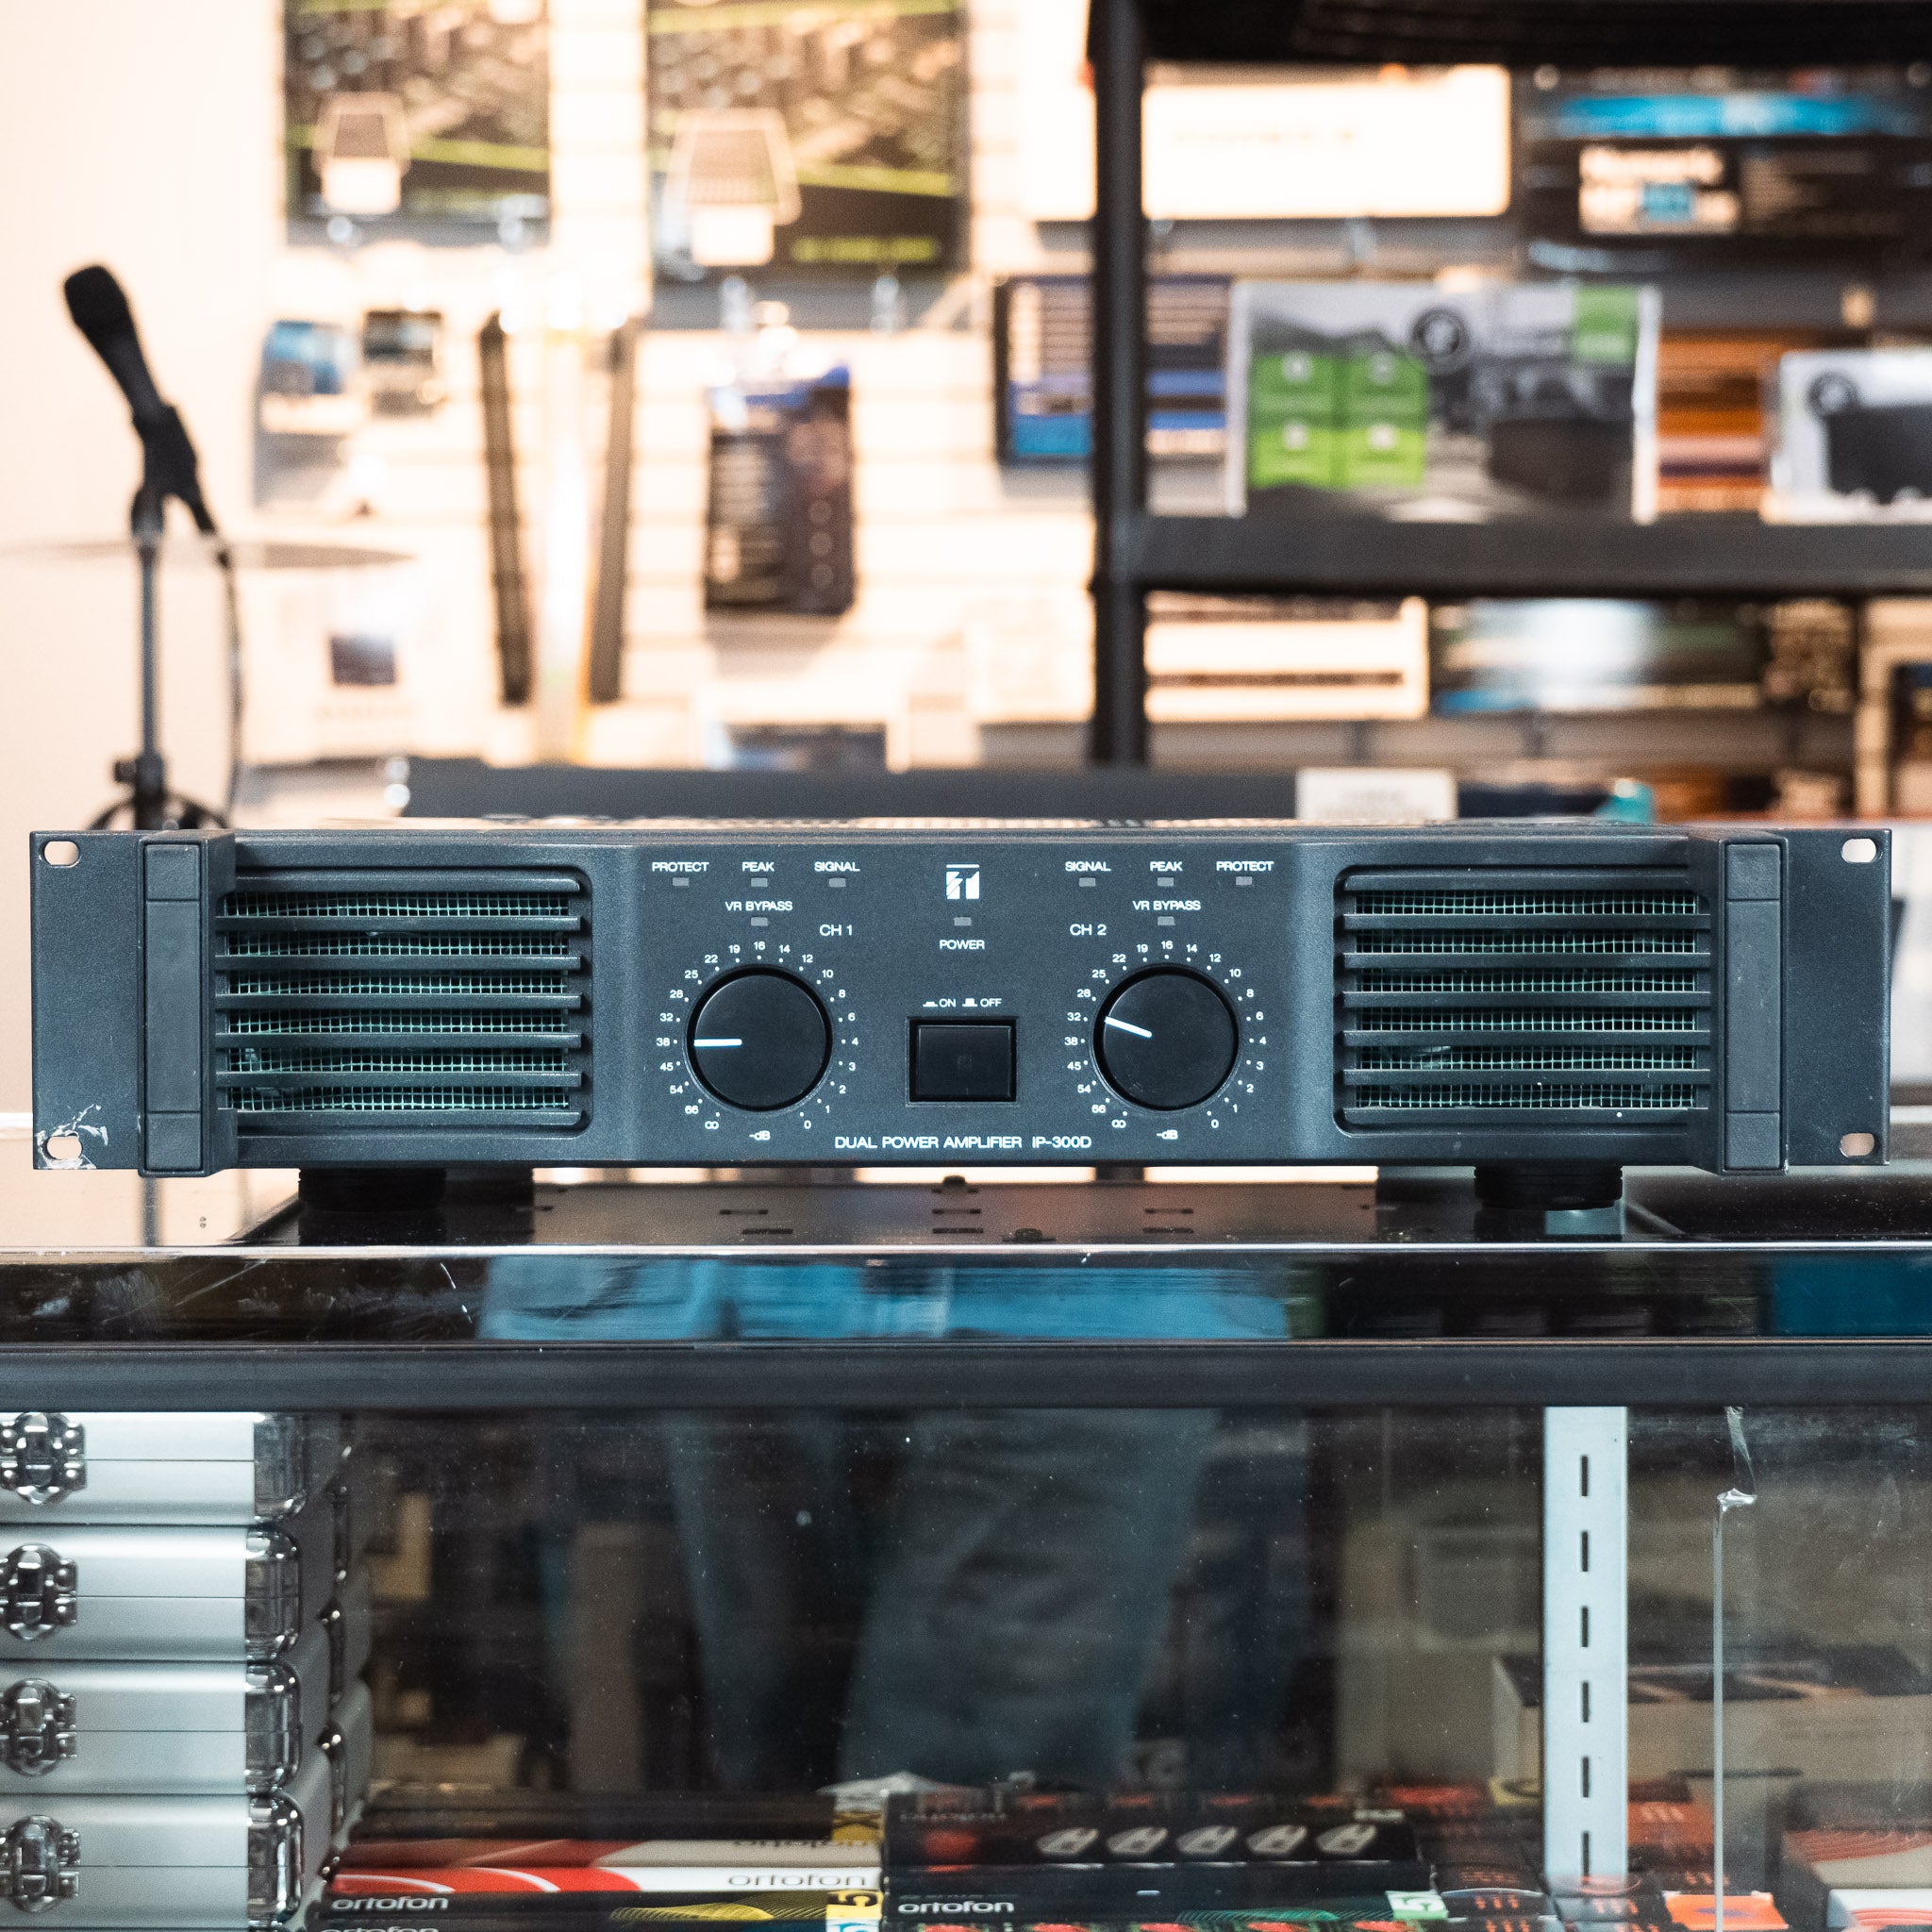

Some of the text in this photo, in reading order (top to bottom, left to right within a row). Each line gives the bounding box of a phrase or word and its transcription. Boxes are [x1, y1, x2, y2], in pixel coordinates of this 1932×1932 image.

[651, 861, 710, 873] PROTECT
[741, 861, 775, 873] PEAK
[814, 860, 861, 873] SIGNAL
[1064, 860, 1111, 873] SIGNAL
[1149, 860, 1183, 872] PEAK
[1216, 860, 1274, 872] PROTECT
[724, 900, 793, 911] VR BYPASS
[1132, 899, 1202, 911] VR BYPASS
[819, 924, 853, 937] CH 1
[1069, 923, 1108, 936] CH 2
[728, 943, 741, 954] 19
[753, 941, 766, 951] 16
[778, 944, 791, 954] 14
[939, 939, 986, 950] POWER
[1136, 943, 1149, 954] 19
[1160, 940, 1174, 950] 16
[1186, 943, 1198, 953] 14
[704, 954, 719, 964] 22
[801, 954, 814, 963] 12
[1111, 953, 1126, 963] 22
[1208, 953, 1222, 963] 12
[684, 969, 699, 979] 25
[821, 969, 834, 978] 10
[1091, 969, 1107, 979] 25
[1228, 968, 1241, 978] 10
[669, 989, 684, 999] 28
[838, 989, 846, 999] 8
[1076, 988, 1091, 998] 28
[1246, 988, 1255, 998] 8
[939, 997, 1003, 1008] ON OFF
[659, 1012, 674, 1023] 32
[847, 1012, 856, 1022] 6
[1067, 1011, 1082, 1022] 32
[1255, 1010, 1264, 1021] 6
[656, 1037, 671, 1047] 38
[851, 1037, 859, 1046] 4
[1064, 1036, 1078, 1046] 38
[1258, 1036, 1267, 1045] 4
[659, 1061, 675, 1072] 45
[848, 1061, 857, 1072] 3
[1067, 1060, 1082, 1071] 45
[1256, 1060, 1264, 1071] 3
[669, 1085, 684, 1094] 54
[839, 1084, 847, 1094] 2
[1076, 1084, 1091, 1094] 54
[1246, 1083, 1255, 1093] 2
[684, 1105, 699, 1115] 66
[824, 1105, 830, 1114] 1
[1091, 1104, 1107, 1114] 66
[1232, 1103, 1238, 1113] 1
[803, 1119, 812, 1130] 0
[1210, 1118, 1220, 1129] 0
[834, 1135, 1092, 1149] DUAL POWER AMPLIFIER IP-300D
[727, 1874, 866, 1887] ortofon
[331, 1896, 449, 1910] ortofon
[897, 1900, 1015, 1914] ortofon
